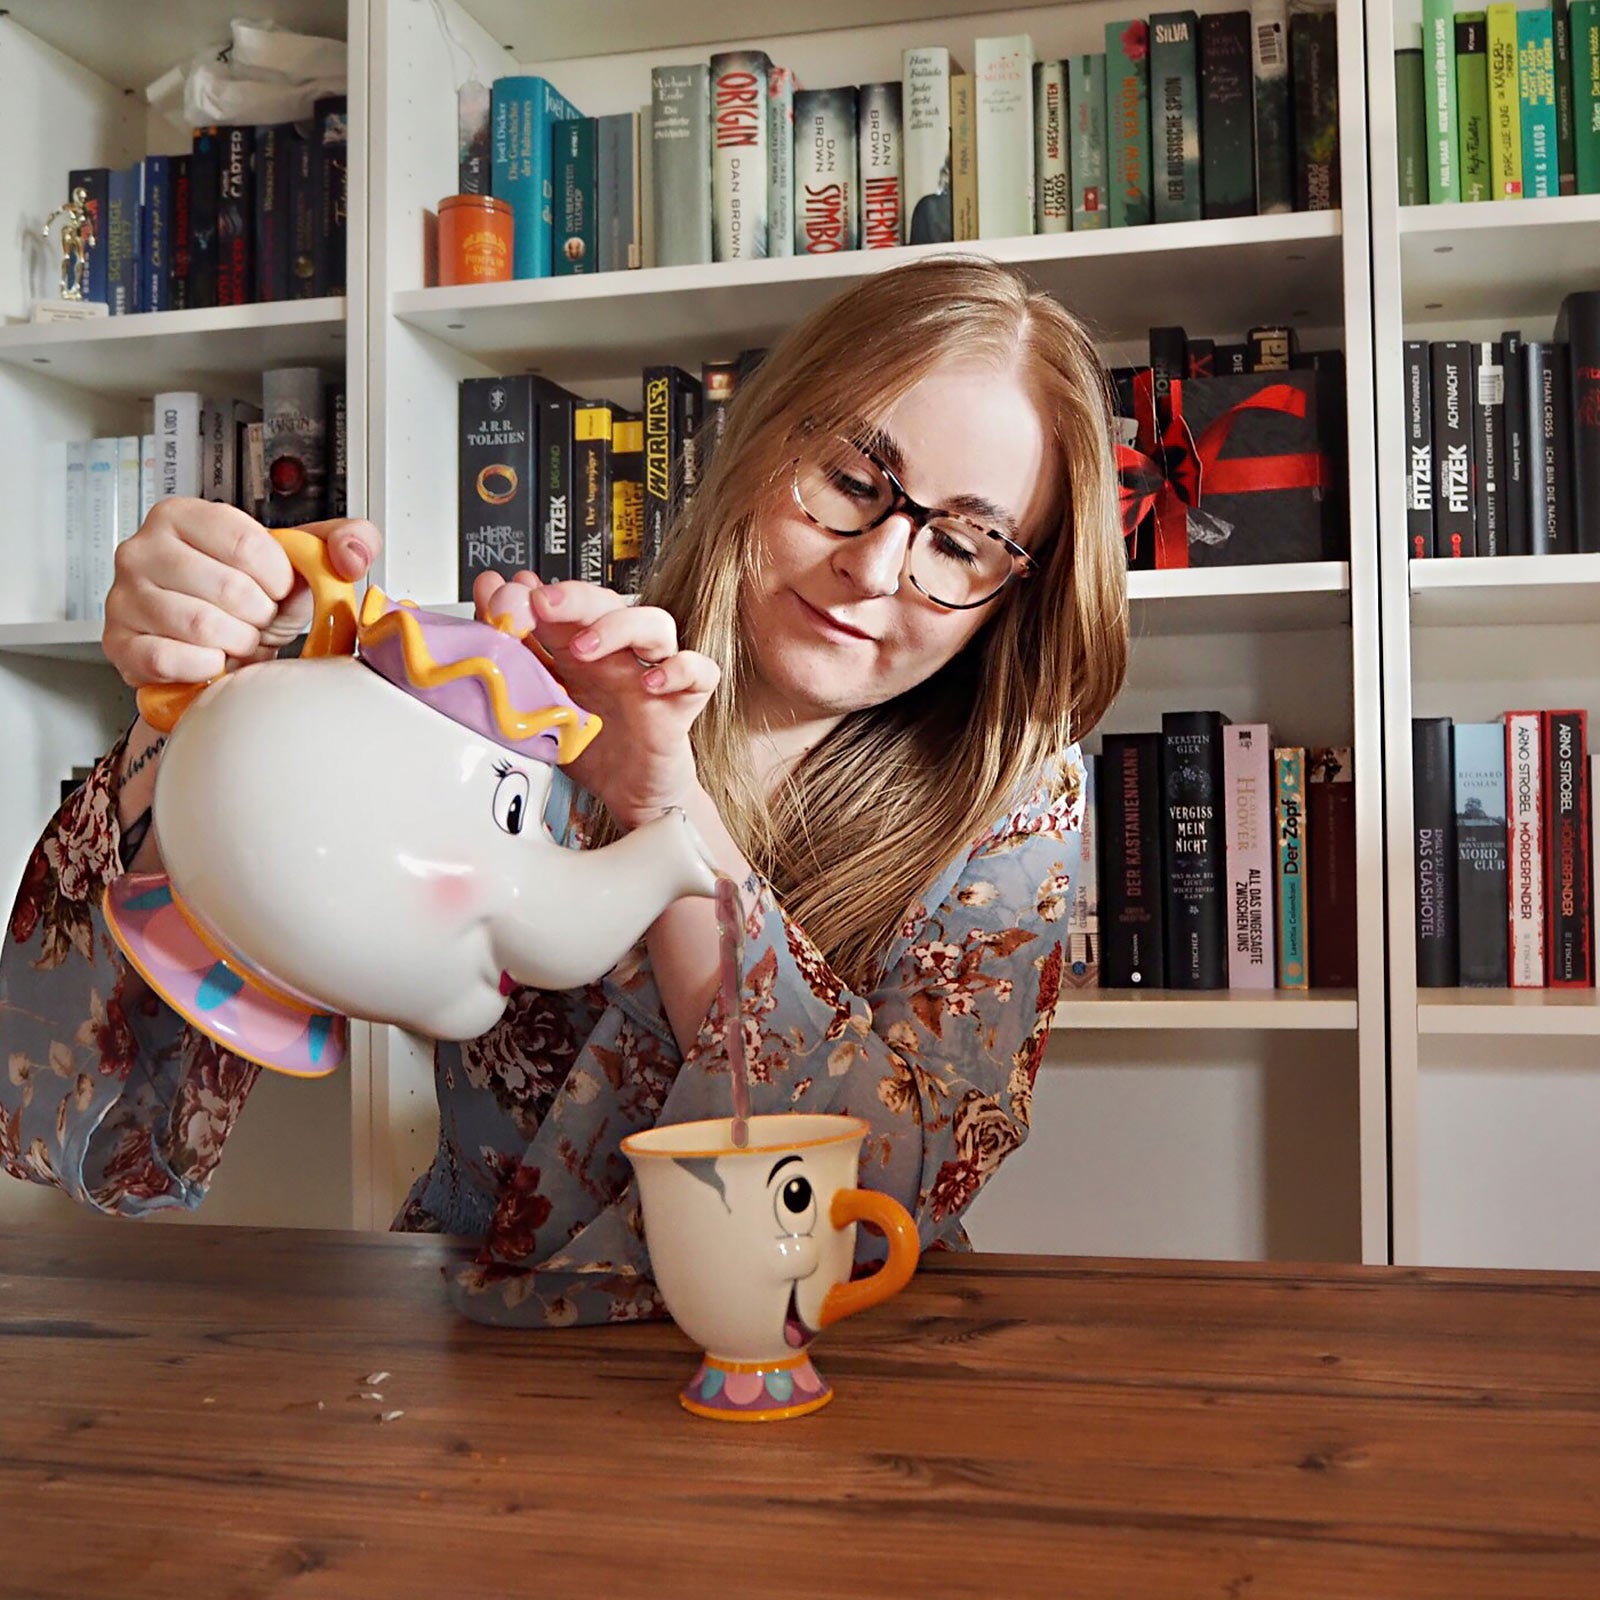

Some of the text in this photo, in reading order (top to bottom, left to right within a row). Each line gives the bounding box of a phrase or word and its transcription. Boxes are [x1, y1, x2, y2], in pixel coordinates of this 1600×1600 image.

[1155, 22, 1189, 43] SILVA
[716, 72, 758, 148] ORIGIN
[1123, 77, 1139, 138] SEASON
[1165, 76, 1183, 114] SPION
[497, 102, 508, 163] Joël Dicker
[871, 111, 879, 166] BROWN
[1048, 83, 1058, 159] ABGESCHNITTEN
[1533, 124, 1546, 158] JAKOB
[231, 131, 243, 197] CARTER
[815, 116, 823, 172] BROWN
[826, 139, 835, 172] DAN
[883, 133, 891, 165] DAN
[1124, 145, 1141, 182] NEW
[1044, 178, 1054, 216] FITZEK
[1055, 174, 1066, 218] TSOKOS
[1536, 175, 1547, 197] MAX
[731, 159, 741, 259] DAN BROWN
[804, 184, 841, 254] SYMBO
[108, 200, 121, 282] SCHWEIGE
[1232, 353, 1243, 373] DIE
[1446, 364, 1459, 429] ACHTNACHT
[165, 410, 177, 436] CODY
[468, 431, 525, 446] TOLKIEN
[647, 376, 669, 500] WAR WAS?
[214, 443, 223, 488] STROBEL
[1543, 369, 1557, 539] ETHAN CROSS ICH BIN DIE NACHT
[1412, 445, 1431, 510] FITZEK
[1448, 445, 1469, 512] FITZEK
[480, 525, 513, 545] HERR
[549, 495, 566, 554] FITZEK
[585, 507, 595, 526] Der
[616, 514, 624, 531] Der
[468, 542, 526, 567] RINGE
[580, 541, 589, 582] BASTIAN
[588, 532, 602, 586] ITZEK
[1167, 735, 1210, 745] KERSTIN
[1176, 743, 1200, 754] GIER
[1518, 726, 1530, 761] ARNO
[1459, 771, 1503, 779] RICHARD
[1519, 763, 1531, 816] STROBEL
[1121, 747, 1141, 865] KASTANIENMANN
[1169, 805, 1214, 820] VERGISS
[1175, 837, 1208, 854] NICHT
[1177, 821, 1206, 837] MEIN
[1282, 799, 1301, 875] Der Zopf
[1435, 829, 1444, 856] EMILY
[1459, 848, 1498, 860] MORD
[1474, 860, 1506, 871] CLUB
[1520, 821, 1533, 920] MÖRDERFINDER
[1559, 723, 1575, 980] ARNO STROBEL MÖRDERFINDER FISCHER
[1126, 867, 1142, 897] DER
[1419, 829, 1434, 939] DAS GLASHOTEL
[1435, 872, 1444, 899] JOHN
[1236, 882, 1249, 952] ZWISCHEN UNS
[1249, 869, 1263, 965] ALL DAS UNGESAGTE
